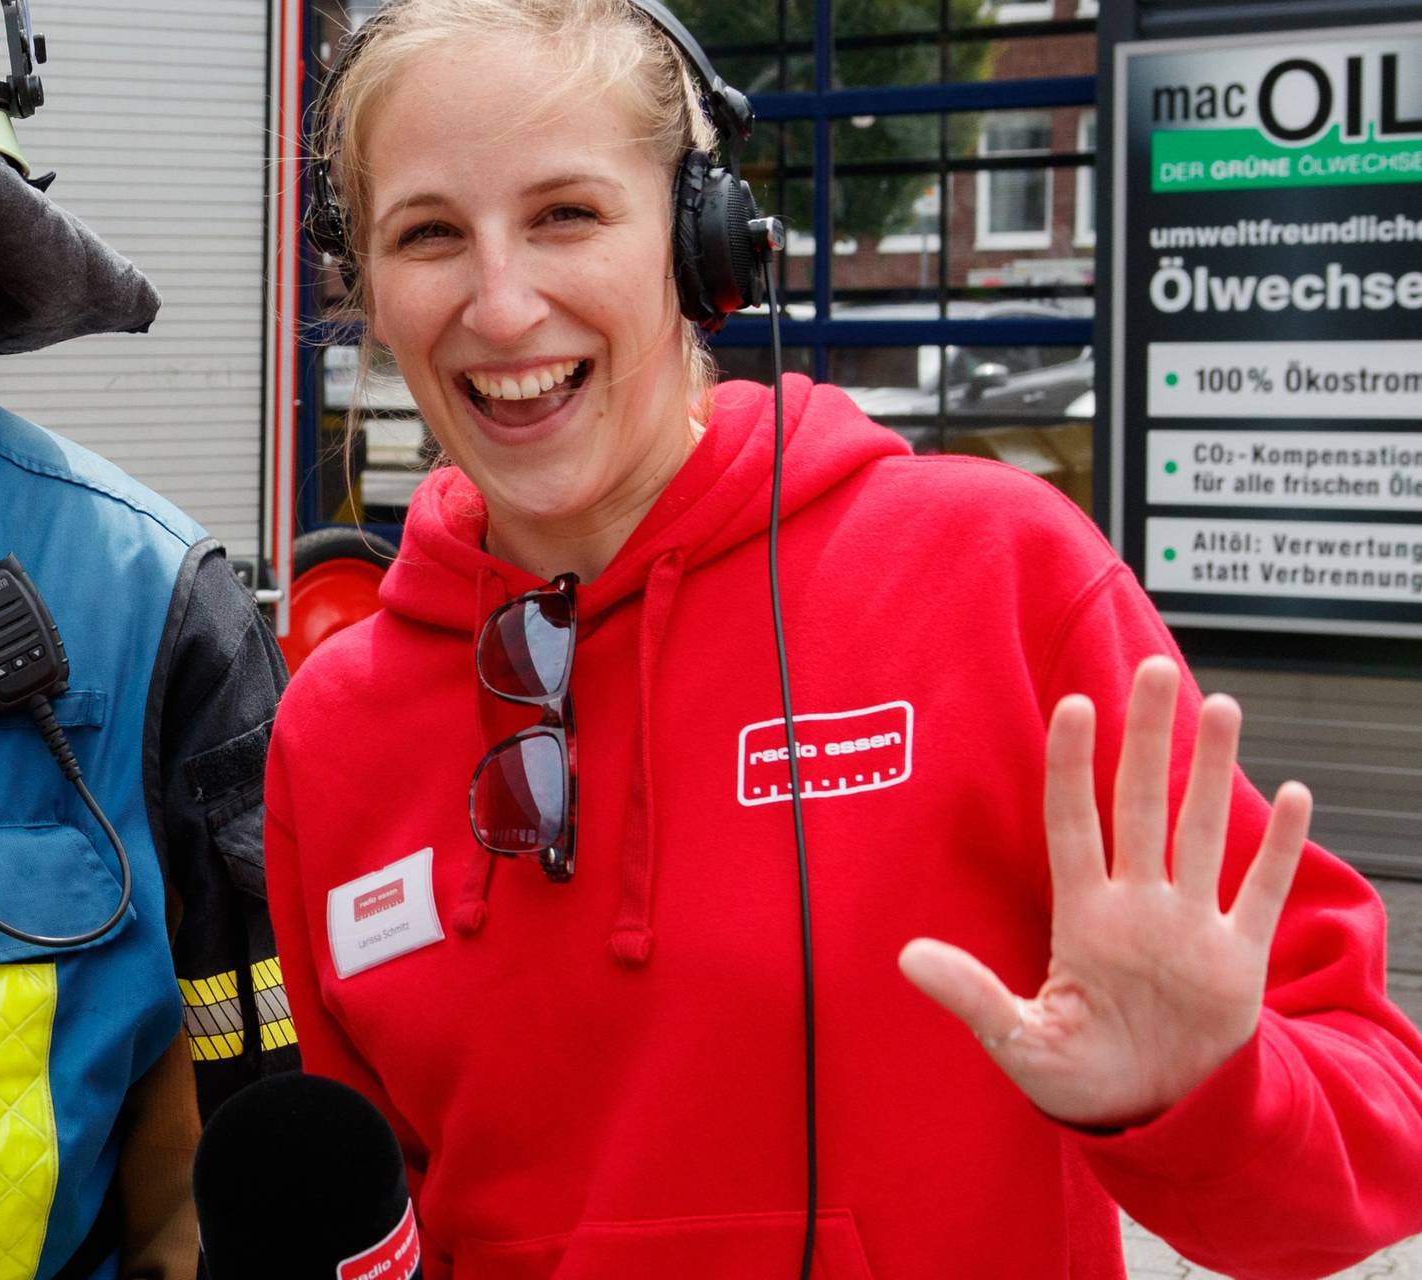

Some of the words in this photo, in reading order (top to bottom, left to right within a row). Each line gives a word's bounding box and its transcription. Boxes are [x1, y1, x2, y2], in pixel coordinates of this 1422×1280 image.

[1153, 82, 1245, 121] mac
[1258, 54, 1422, 141] OIL
[1159, 161, 1204, 182] DER
[1210, 155, 1291, 180] GRÜNE
[1149, 256, 1422, 313] Ölwechse
[1192, 472, 1224, 493] für
[1234, 473, 1274, 494] alle
[1284, 475, 1379, 496] frischen
[1192, 531, 1262, 554] Altöl:
[1273, 535, 1422, 564] Verwertung
[1192, 562, 1249, 582] statt
[1260, 564, 1422, 594] Verbrennung
[824, 731, 901, 756] essen
